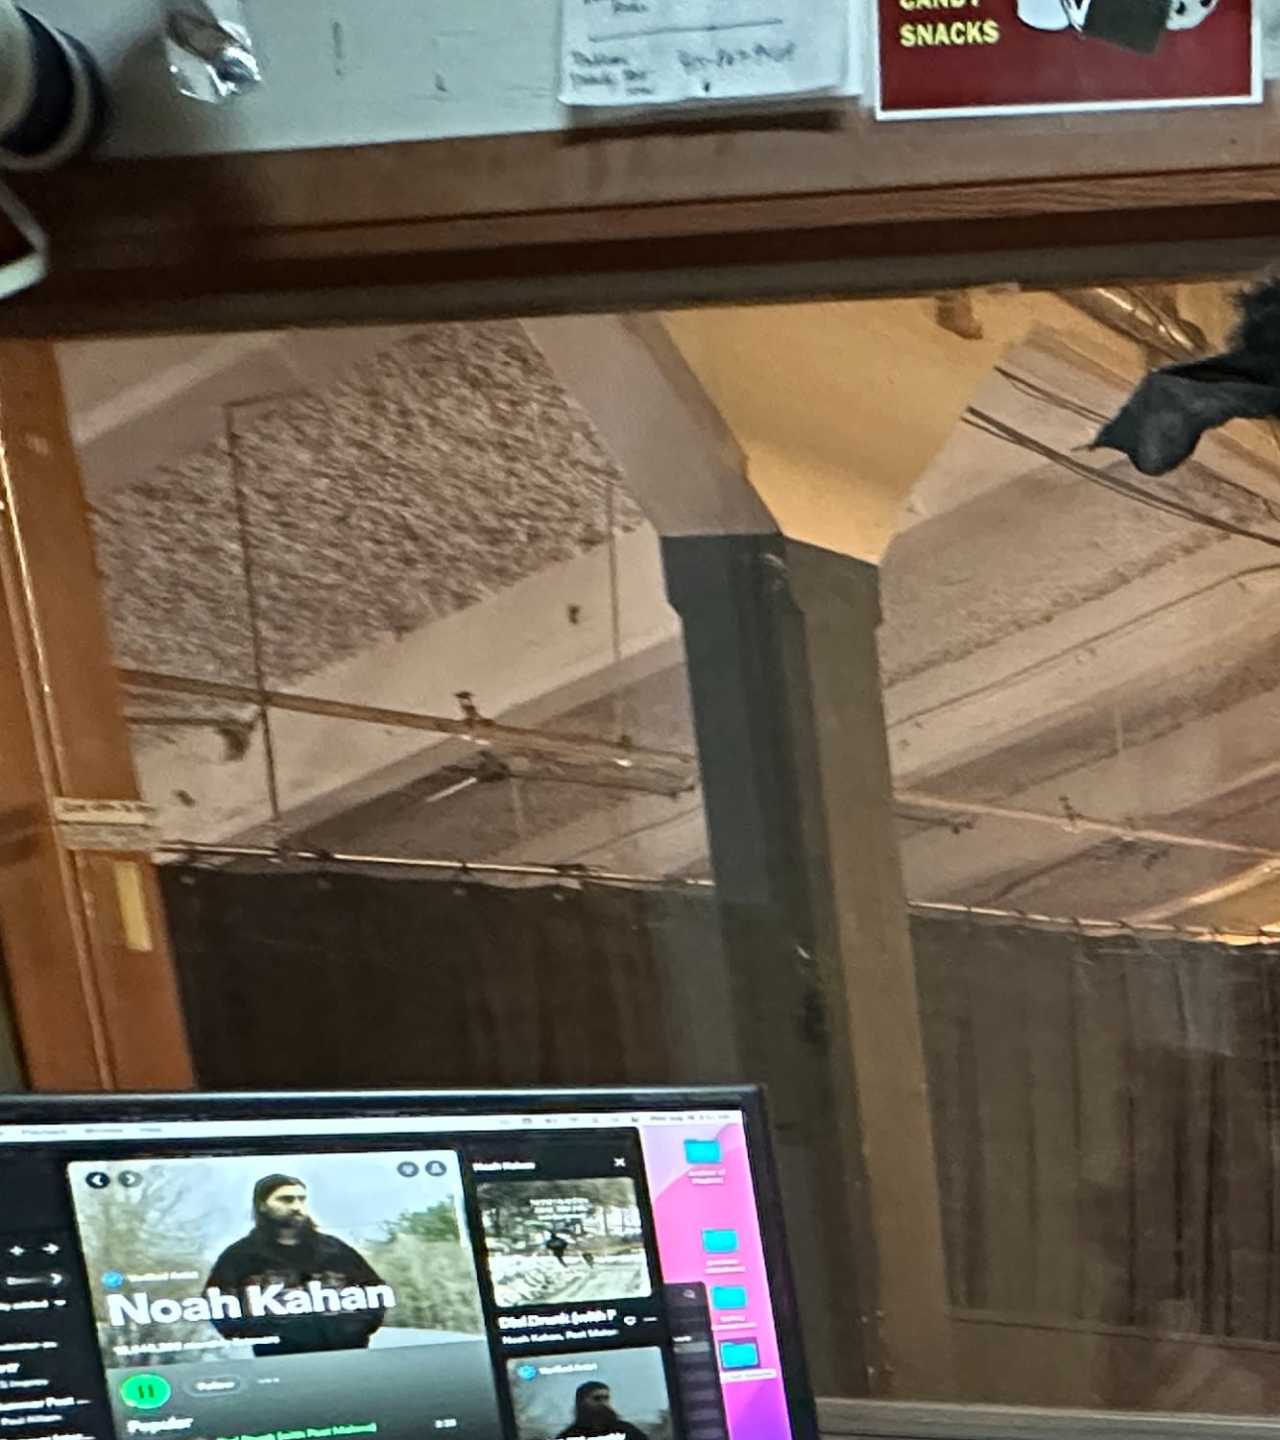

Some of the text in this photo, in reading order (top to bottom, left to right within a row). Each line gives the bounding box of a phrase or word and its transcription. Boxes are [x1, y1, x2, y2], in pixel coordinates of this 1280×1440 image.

[900, 20, 1000, 46] SNACKS
[106, 1281, 396, 1327] Noah Kahan
